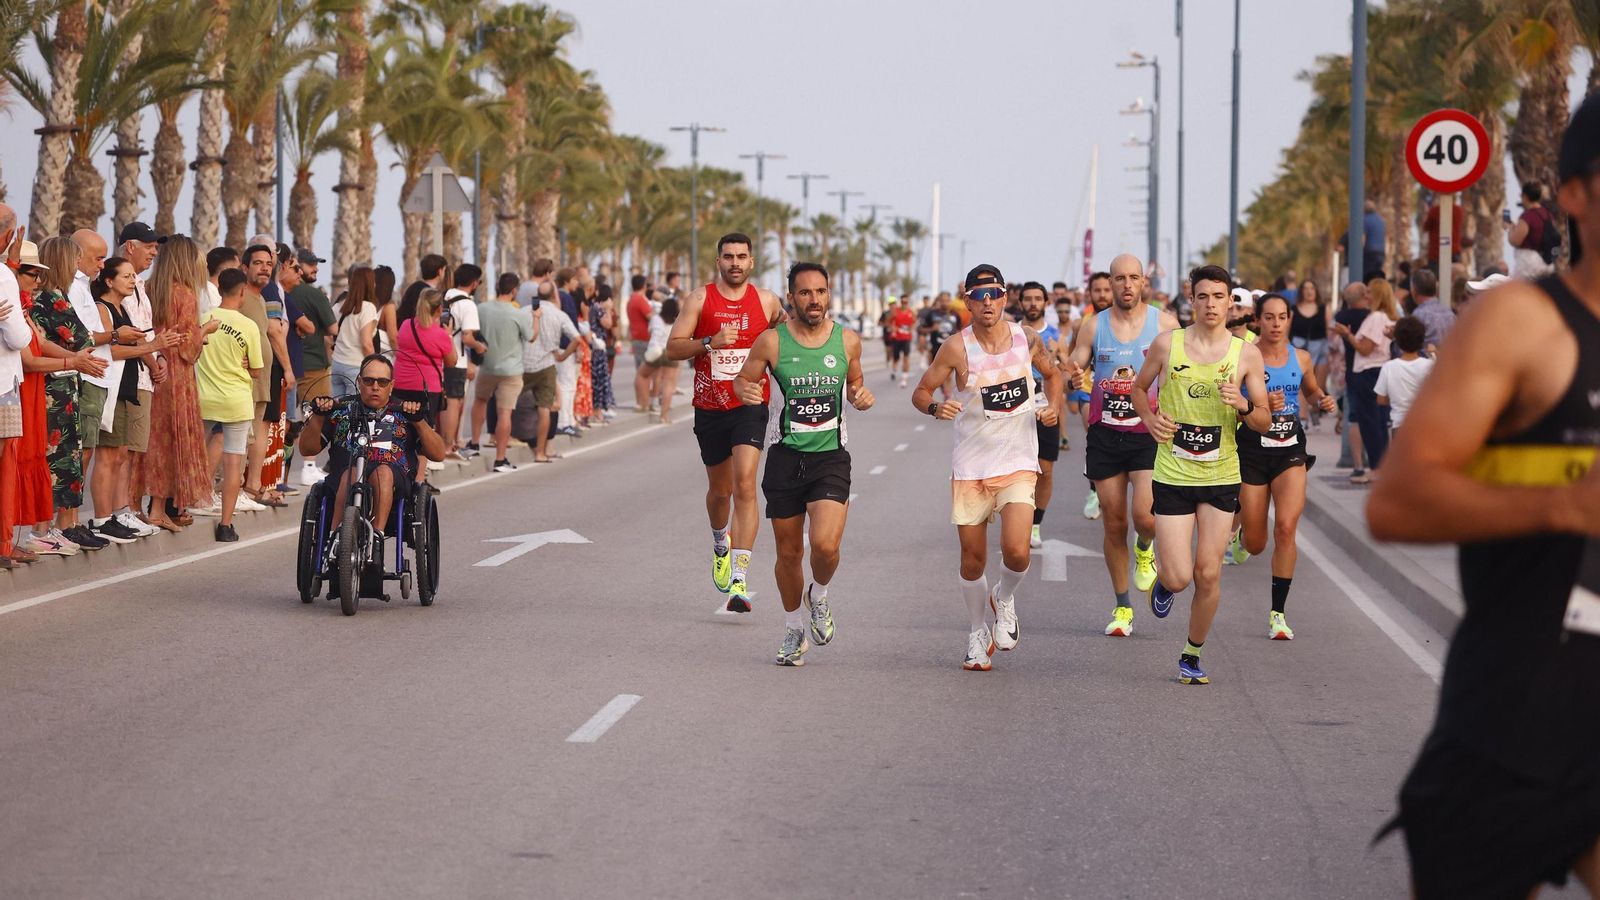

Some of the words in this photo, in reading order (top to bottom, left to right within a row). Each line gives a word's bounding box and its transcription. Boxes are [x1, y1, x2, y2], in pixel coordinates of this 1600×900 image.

[1424, 134, 1468, 165] 40
[220, 323, 246, 348] ngeles
[717, 355, 746, 365] 3597
[790, 371, 840, 389] mijas
[990, 387, 1021, 403] 2716
[797, 403, 831, 415] 2695
[1269, 421, 1294, 432] 2567
[1181, 430, 1214, 444] 1348
